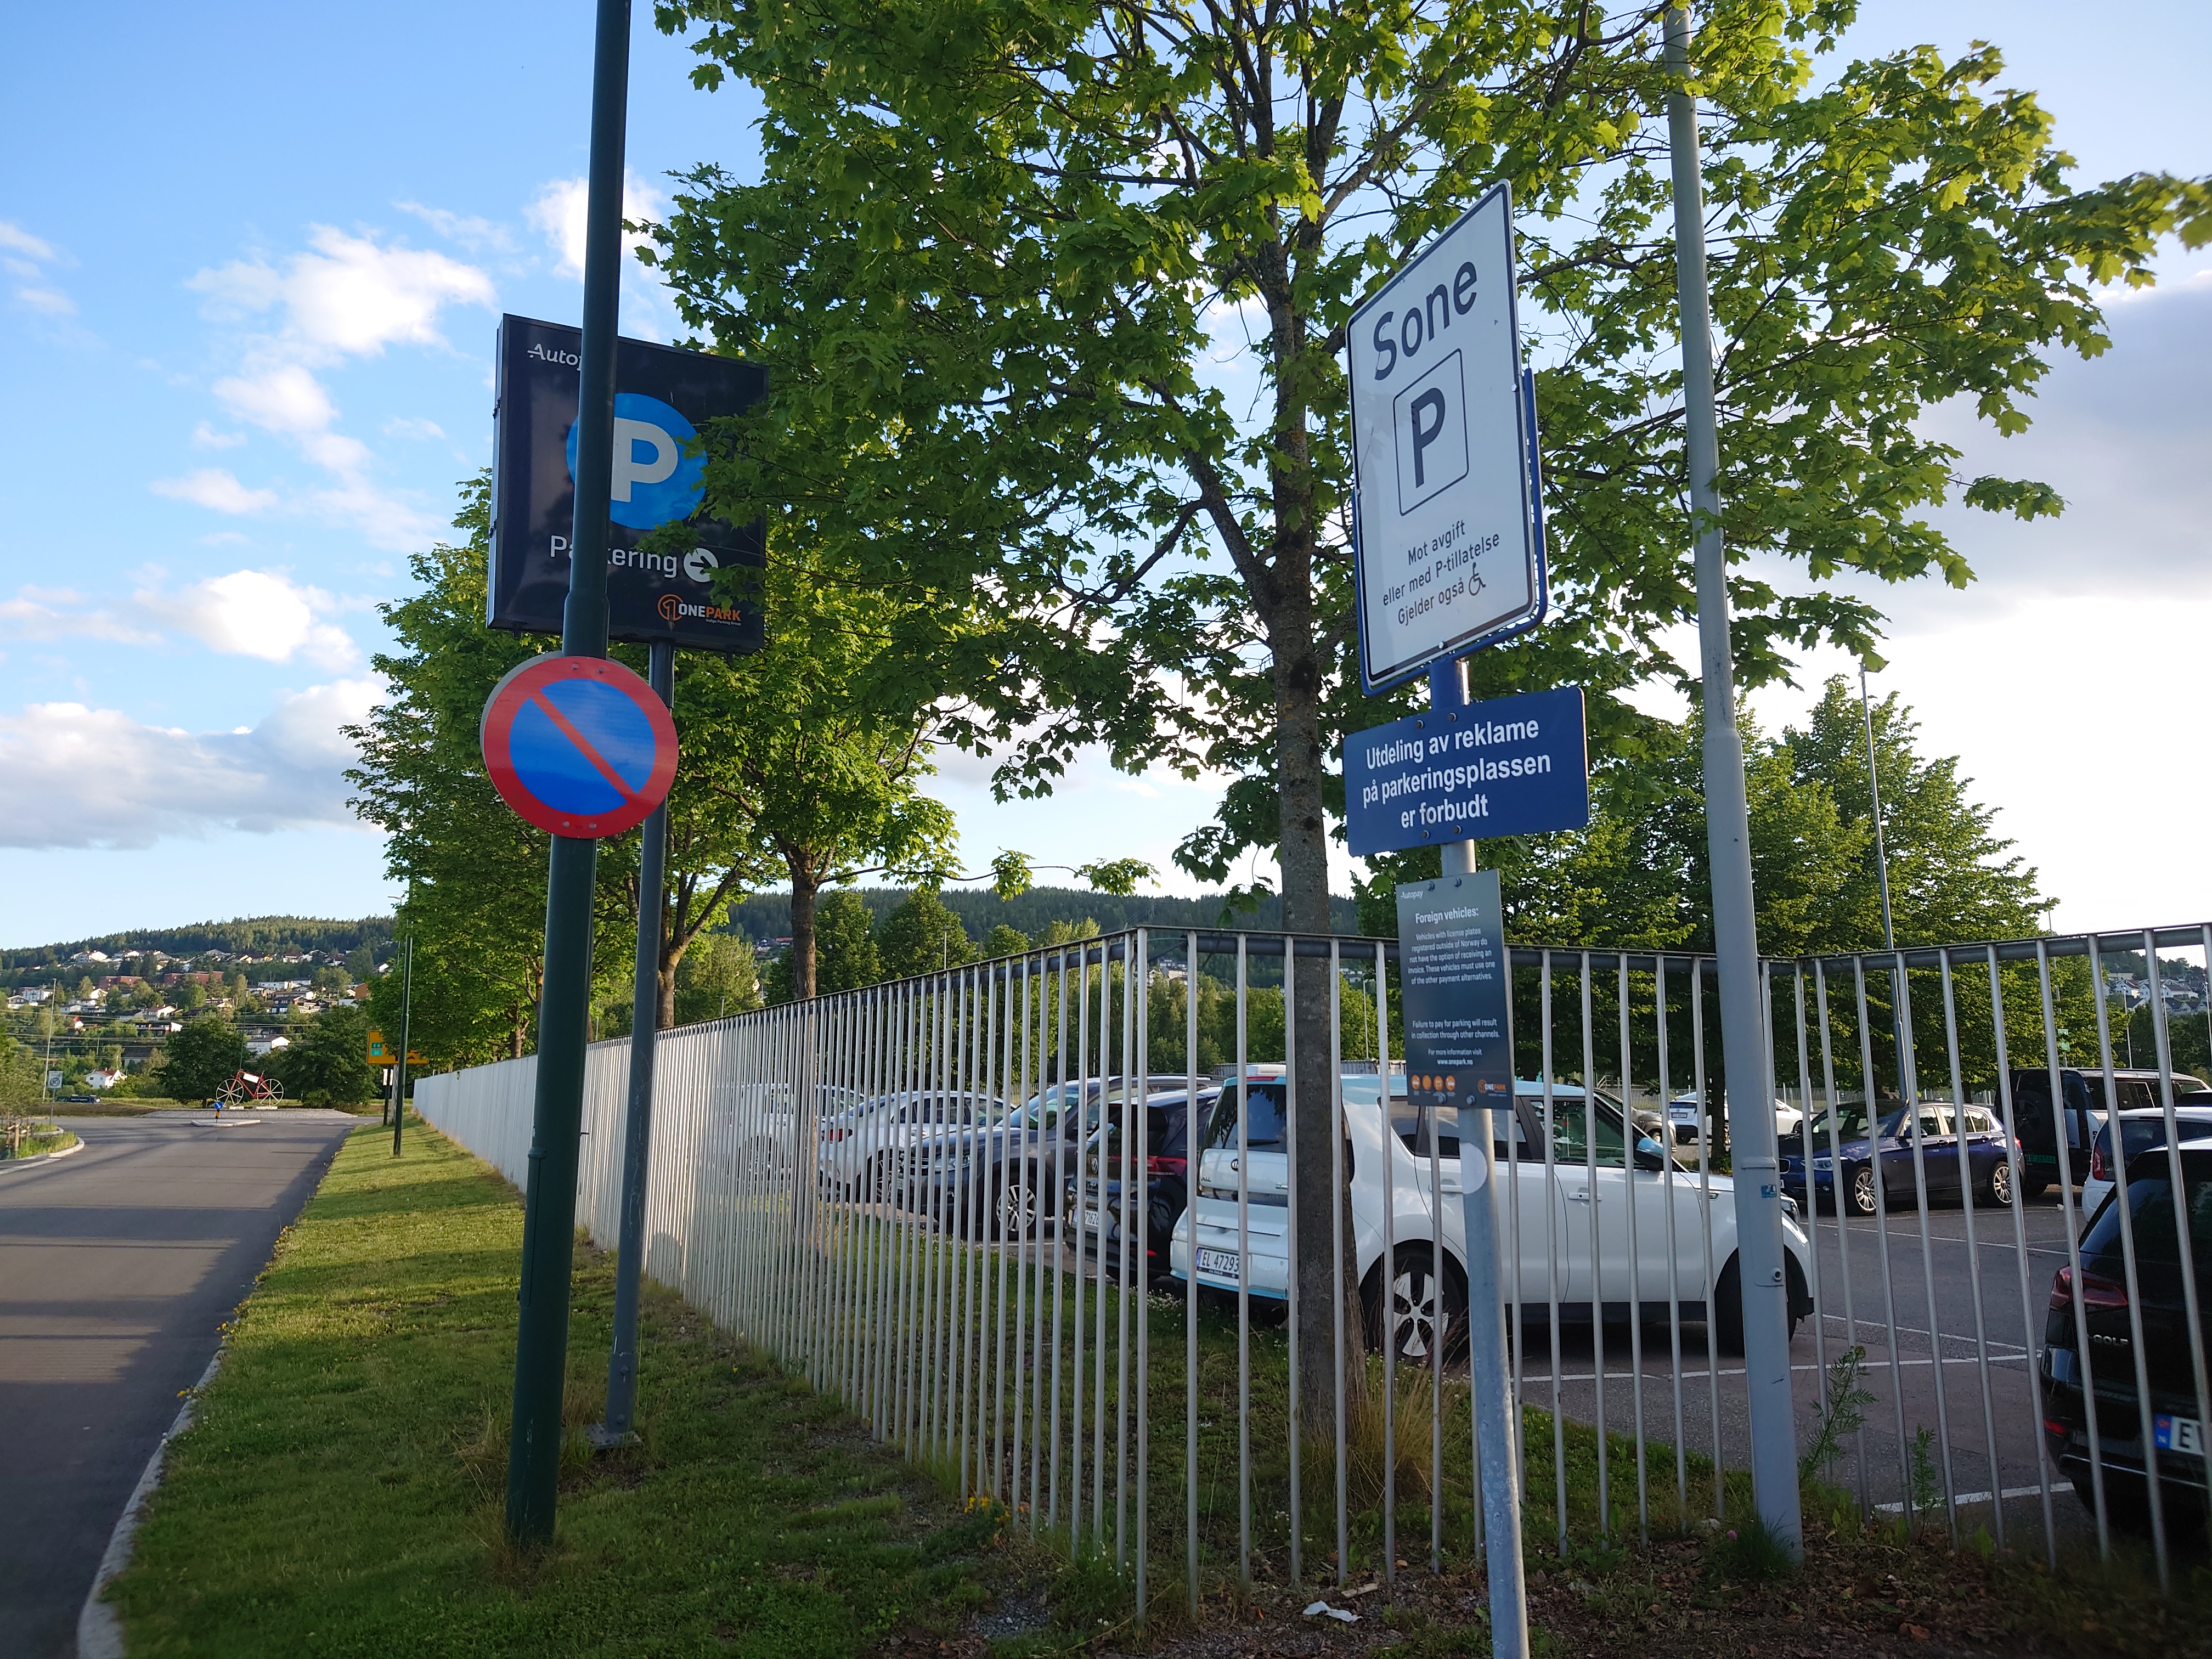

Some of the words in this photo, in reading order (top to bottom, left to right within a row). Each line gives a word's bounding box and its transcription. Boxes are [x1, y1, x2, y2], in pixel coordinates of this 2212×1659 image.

[1374, 261, 1477, 381] Sone
[527, 343, 582, 371] Auto
[1411, 387, 1446, 489] P
[611, 417, 678, 503] P
[550, 535, 678, 578] Pering
[1408, 541, 1427, 566] Mot
[1432, 520, 1465, 549] avgift
[1383, 584, 1405, 606] eller
[1409, 566, 1431, 592] med
[1436, 533, 1499, 578] P-tillatelse
[1398, 596, 1434, 626] Gjelder
[1438, 577, 1464, 605] også
[1365, 738, 1423, 770] Utdeling
[1429, 734, 1450, 754] av
[1455, 720, 1539, 749] reklame
[1363, 778, 1378, 809] på
[1382, 754, 1551, 804] parkeringsplassen
[1401, 809, 1416, 828] er
[1419, 793, 1489, 825] forbudt
[1401, 890, 1423, 900] Autopay
[1415, 911, 1443, 924] Foreign
[1444, 906, 1479, 921] vehicles:
[1412, 943, 1435, 953] registered
[1436, 941, 1453, 950] outside
[1460, 939, 1480, 947] Norway
[1481, 937, 1488, 945] do
[1415, 932, 1435, 941] Vehicles
[1465, 928, 1481, 937] plates
[1438, 952, 1454, 962] option
[1461, 950, 1484, 959] receiving
[1425, 975, 1438, 984] other
[1438, 975, 1460, 985] payment
[1461, 972, 1492, 981] alternatives.
[1416, 1031, 1439, 1039] collection
[1440, 1031, 1459, 1040] through
[1475, 1030, 1500, 1038] channels.
[1435, 1020, 1443, 1029] pay
[1452, 1019, 1471, 1029] parking
[1202, 1251, 1210, 1267] EL
[1214, 1254, 1239, 1272] 47293
[2093, 1334, 2128, 1346] GOLF
